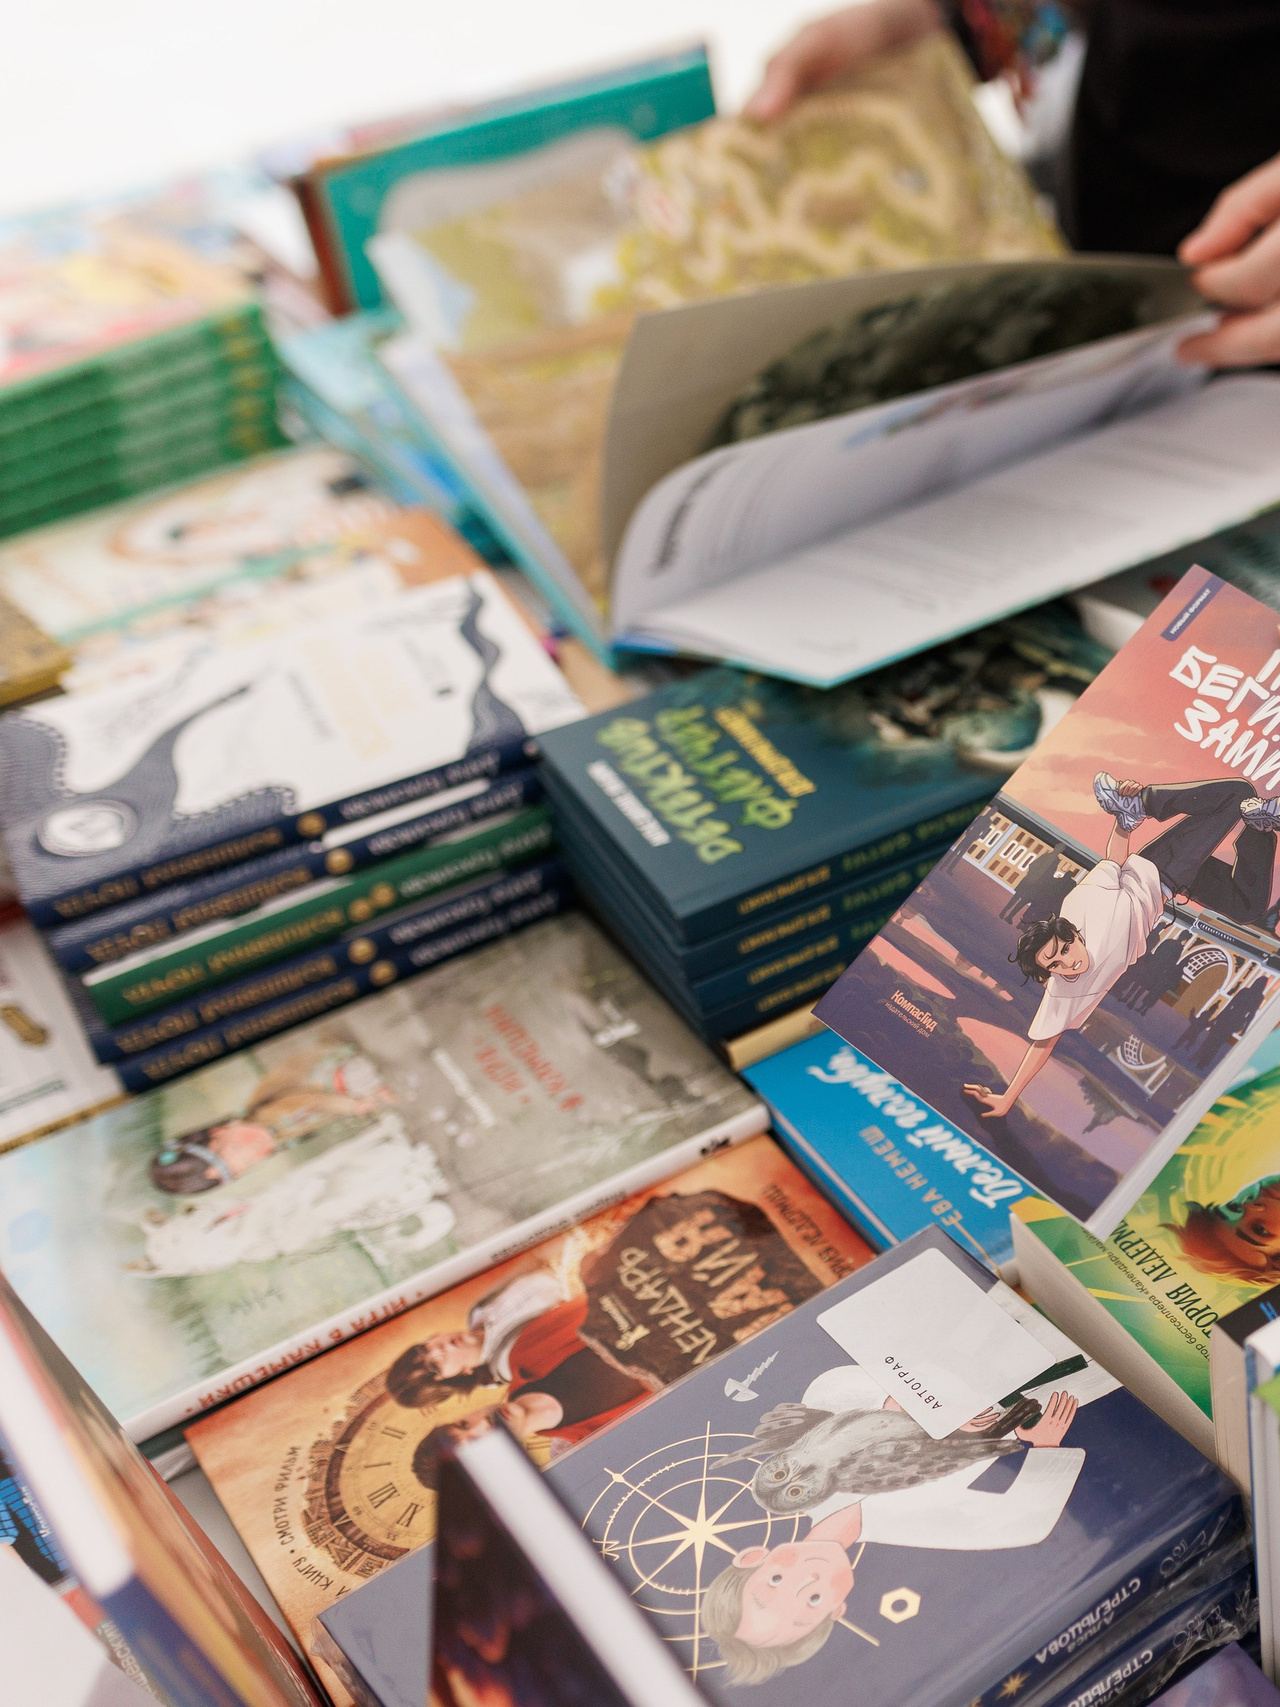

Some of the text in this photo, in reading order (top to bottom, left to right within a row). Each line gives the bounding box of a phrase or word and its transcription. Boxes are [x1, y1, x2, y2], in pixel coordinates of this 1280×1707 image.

[891, 989, 938, 1032] КомпасГид
[916, 1027, 930, 1038] дом
[858, 1122, 964, 1229] ЕВА НЕМЕШ
[904, 1121, 1023, 1216] Белый
[610, 1242, 724, 1365] ЛЕНДАРЬ
[1109, 1219, 1219, 1339] ТОРИЯ ЛЕДЕРМ
[350, 1295, 408, 1334] ИГРА
[1149, 1295, 1197, 1345] бестселлера
[196, 1337, 324, 1411] КАМЕШКИ
[883, 1354, 943, 1413] АВТОГРАФ
[272, 1446, 334, 1592] КНИГУ СМОТРИ ФИЛЬМ
[1034, 1576, 1143, 1665] СТРЕЛЬЦОВА
[1066, 1611, 1116, 1653] Алиса
[1067, 1648, 1153, 1707] СТРЕЛЬЦО
